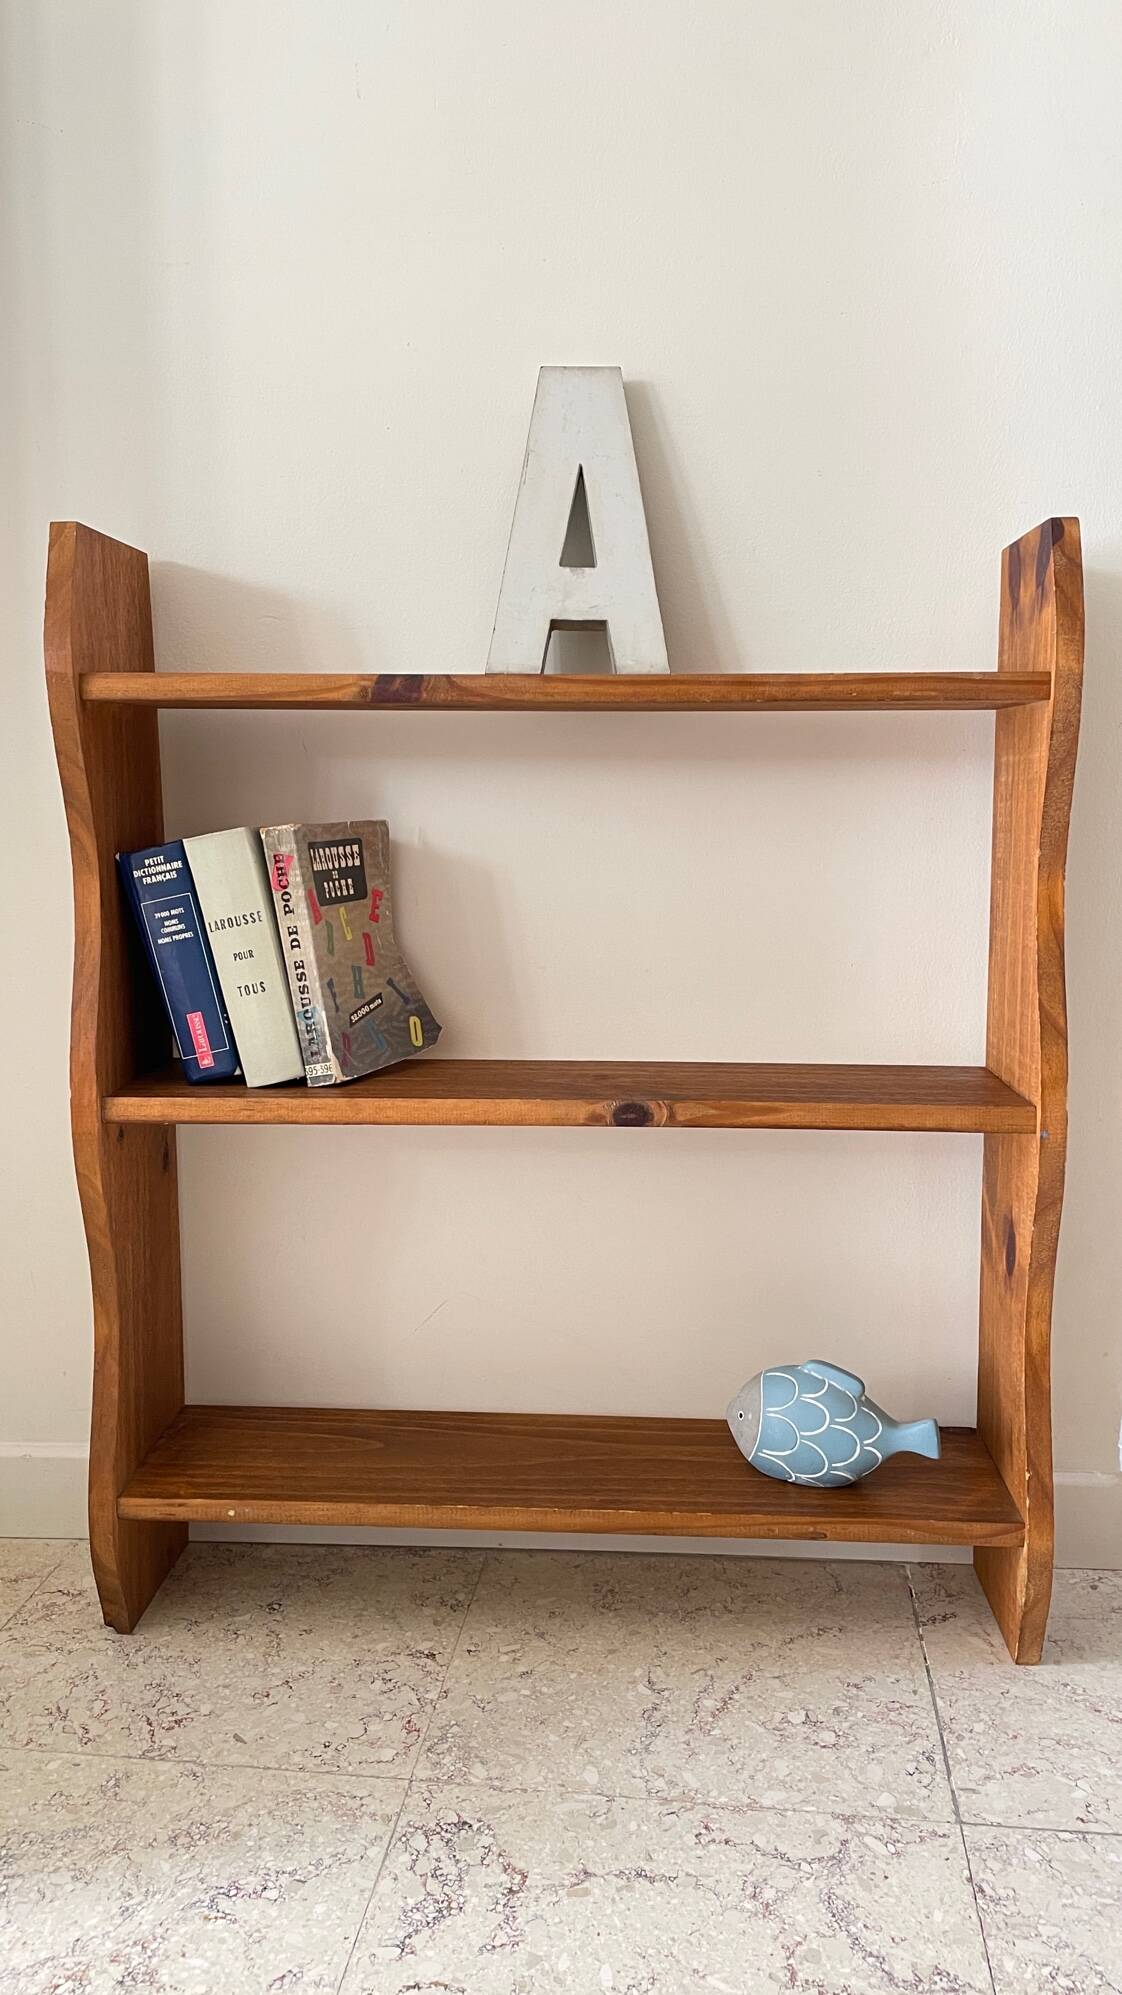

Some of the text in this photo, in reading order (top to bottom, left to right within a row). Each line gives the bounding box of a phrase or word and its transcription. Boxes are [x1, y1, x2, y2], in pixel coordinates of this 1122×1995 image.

[485, 366, 671, 675] A
[144, 855, 165, 867] PETIT
[310, 844, 361, 871] LAROUSSE
[133, 860, 183, 878] DICTIONNAIRE
[142, 870, 177, 885] FRANÇAIS
[273, 853, 295, 917] POCHE
[323, 878, 354, 899] POCHE
[170, 907, 185, 915] MOTS
[160, 923, 186, 934] COMMUNS
[163, 919, 179, 927] NOMS
[208, 910, 263, 933] LAROUSSE
[157, 931, 194, 945] NOMS PROPRES
[287, 925, 302, 950] DE
[233, 949, 255, 962] POUR
[237, 981, 266, 997] TOUS
